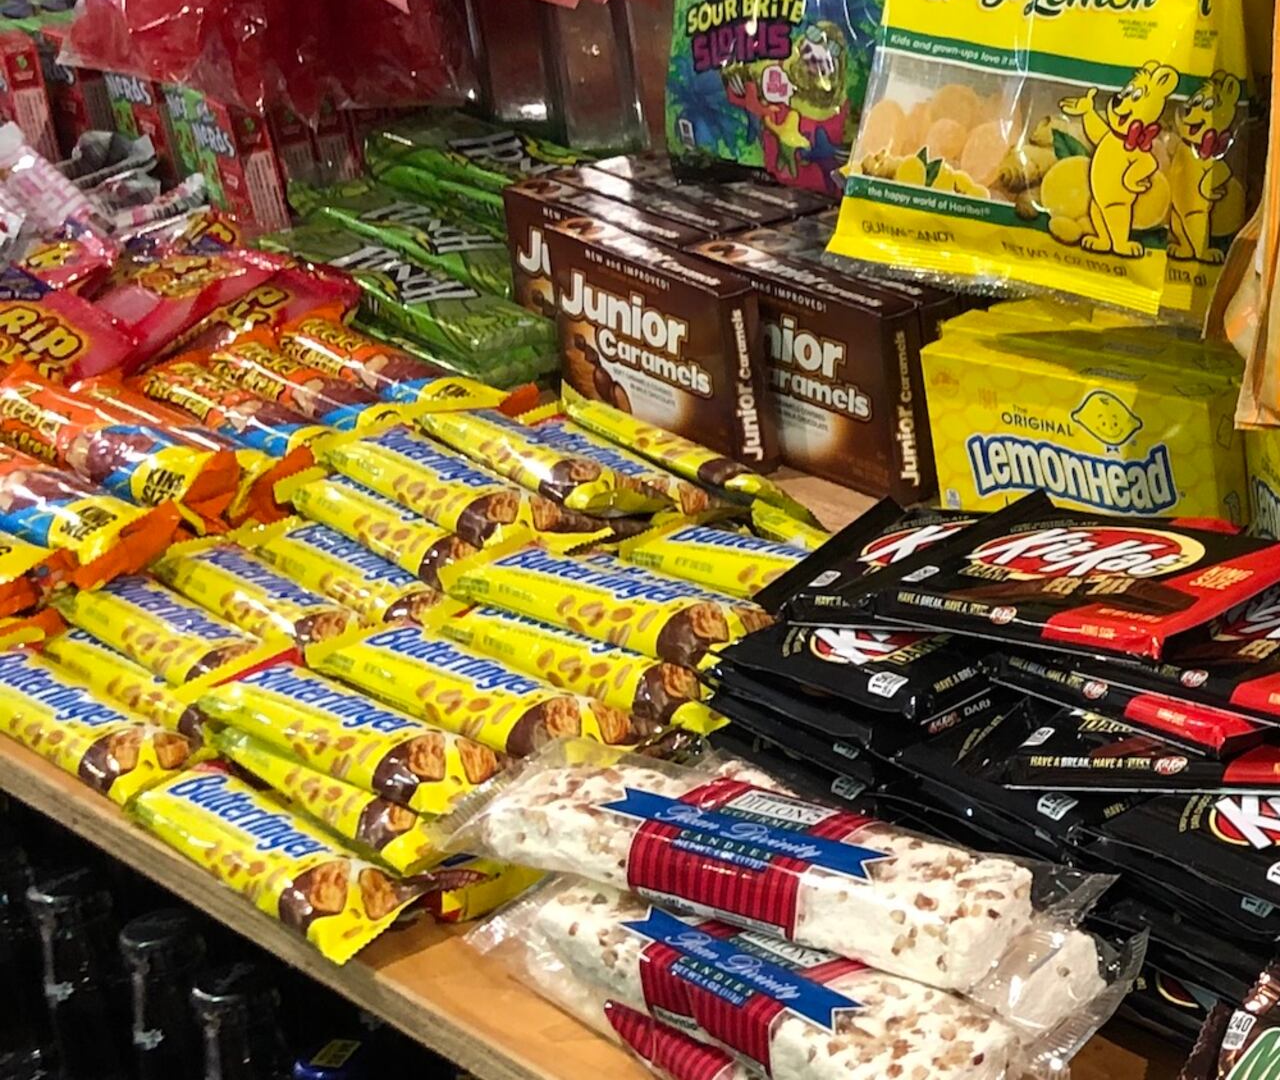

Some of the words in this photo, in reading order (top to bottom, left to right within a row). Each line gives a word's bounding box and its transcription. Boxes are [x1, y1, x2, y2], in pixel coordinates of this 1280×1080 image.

[890, 33, 911, 48] Kids
[913, 37, 932, 51] and
[932, 43, 979, 61] grown-ups
[980, 51, 1001, 65] love
[867, 185, 882, 197] the
[884, 188, 911, 205] happy
[912, 194, 937, 209] world
[585, 248, 604, 265] NEW
[623, 261, 671, 291] IMPROVED!
[561, 272, 688, 357] Junior
[774, 286, 828, 314] IMPROVED!
[598, 328, 713, 396] Caramels
[730, 308, 752, 381] Caramels
[893, 330, 907, 412] Caramels
[741, 380, 764, 461] Junior
[1001, 410, 1075, 438] ORIGINAL
[895, 416, 920, 488] Junior
[287, 525, 420, 587] Butterfinger
[500, 547, 686, 604] Butterfinger
[1208, 565, 1254, 584] KING
[1188, 576, 1235, 591] SIZE
[365, 624, 544, 695] Butterfinger
[244, 663, 423, 733] Butterfinger
[1030, 756, 1056, 768] HAVE
[1093, 757, 1118, 768] HAVE
[169, 772, 330, 860] Butterfinger
[680, 829, 774, 861] CANDIES
[720, 822, 823, 858] Divinity
[680, 956, 754, 997] CANDIES
[716, 954, 801, 1000] Divinity
